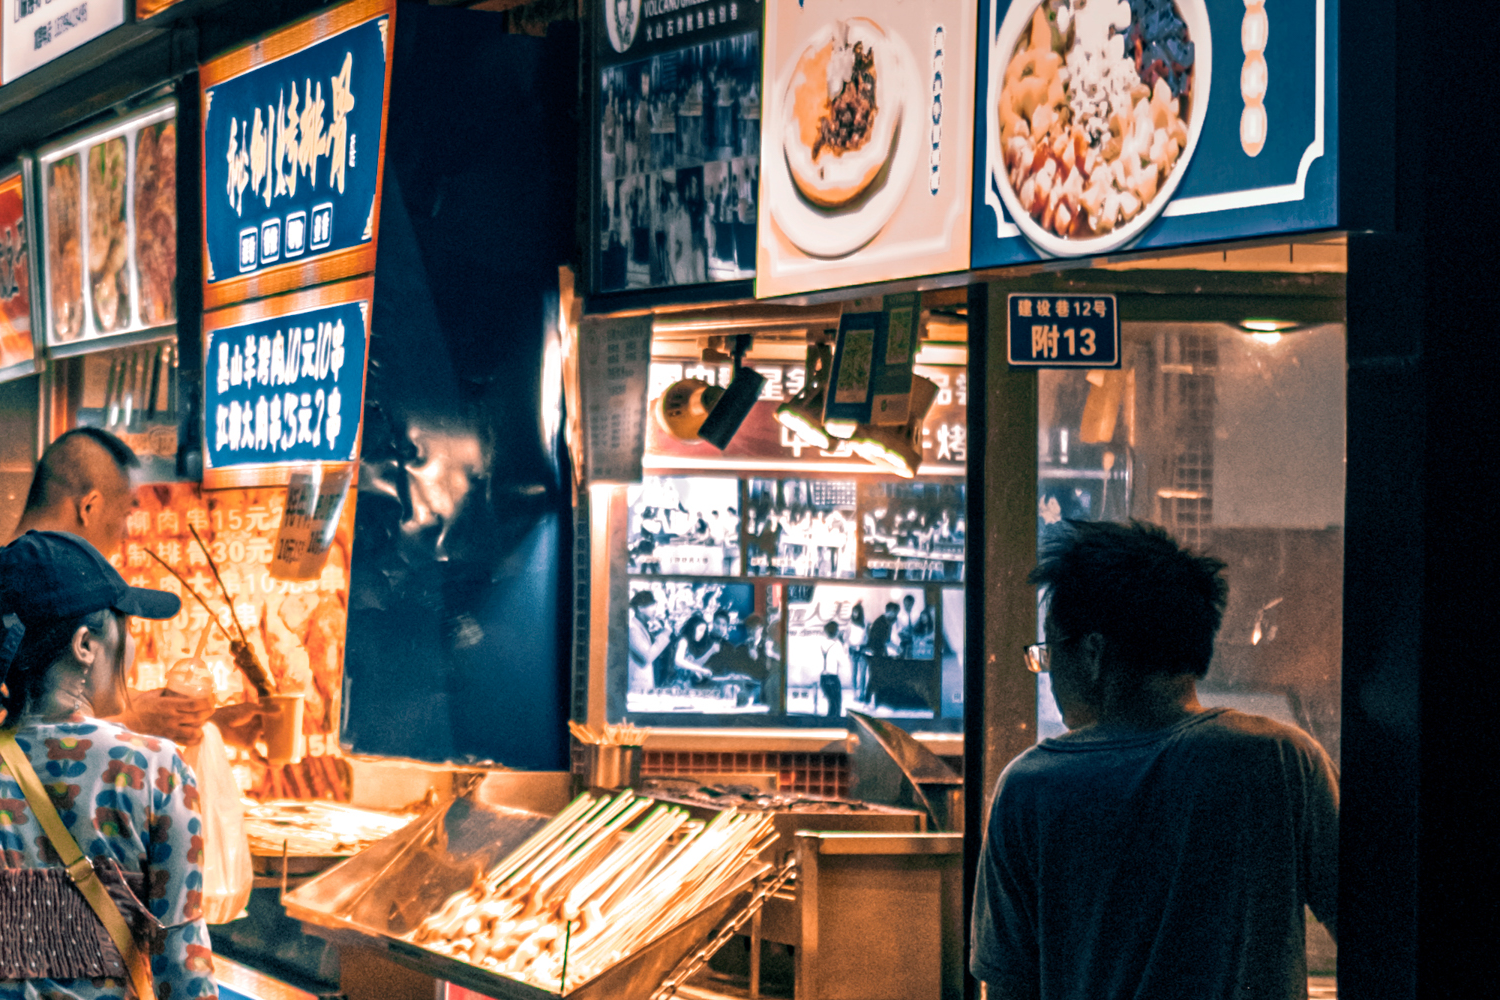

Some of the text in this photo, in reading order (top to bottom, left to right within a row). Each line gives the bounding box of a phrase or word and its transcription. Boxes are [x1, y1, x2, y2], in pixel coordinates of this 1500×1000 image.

[1018, 299, 1106, 318] 建设巷12号
[1031, 324, 1096, 359] 附13
